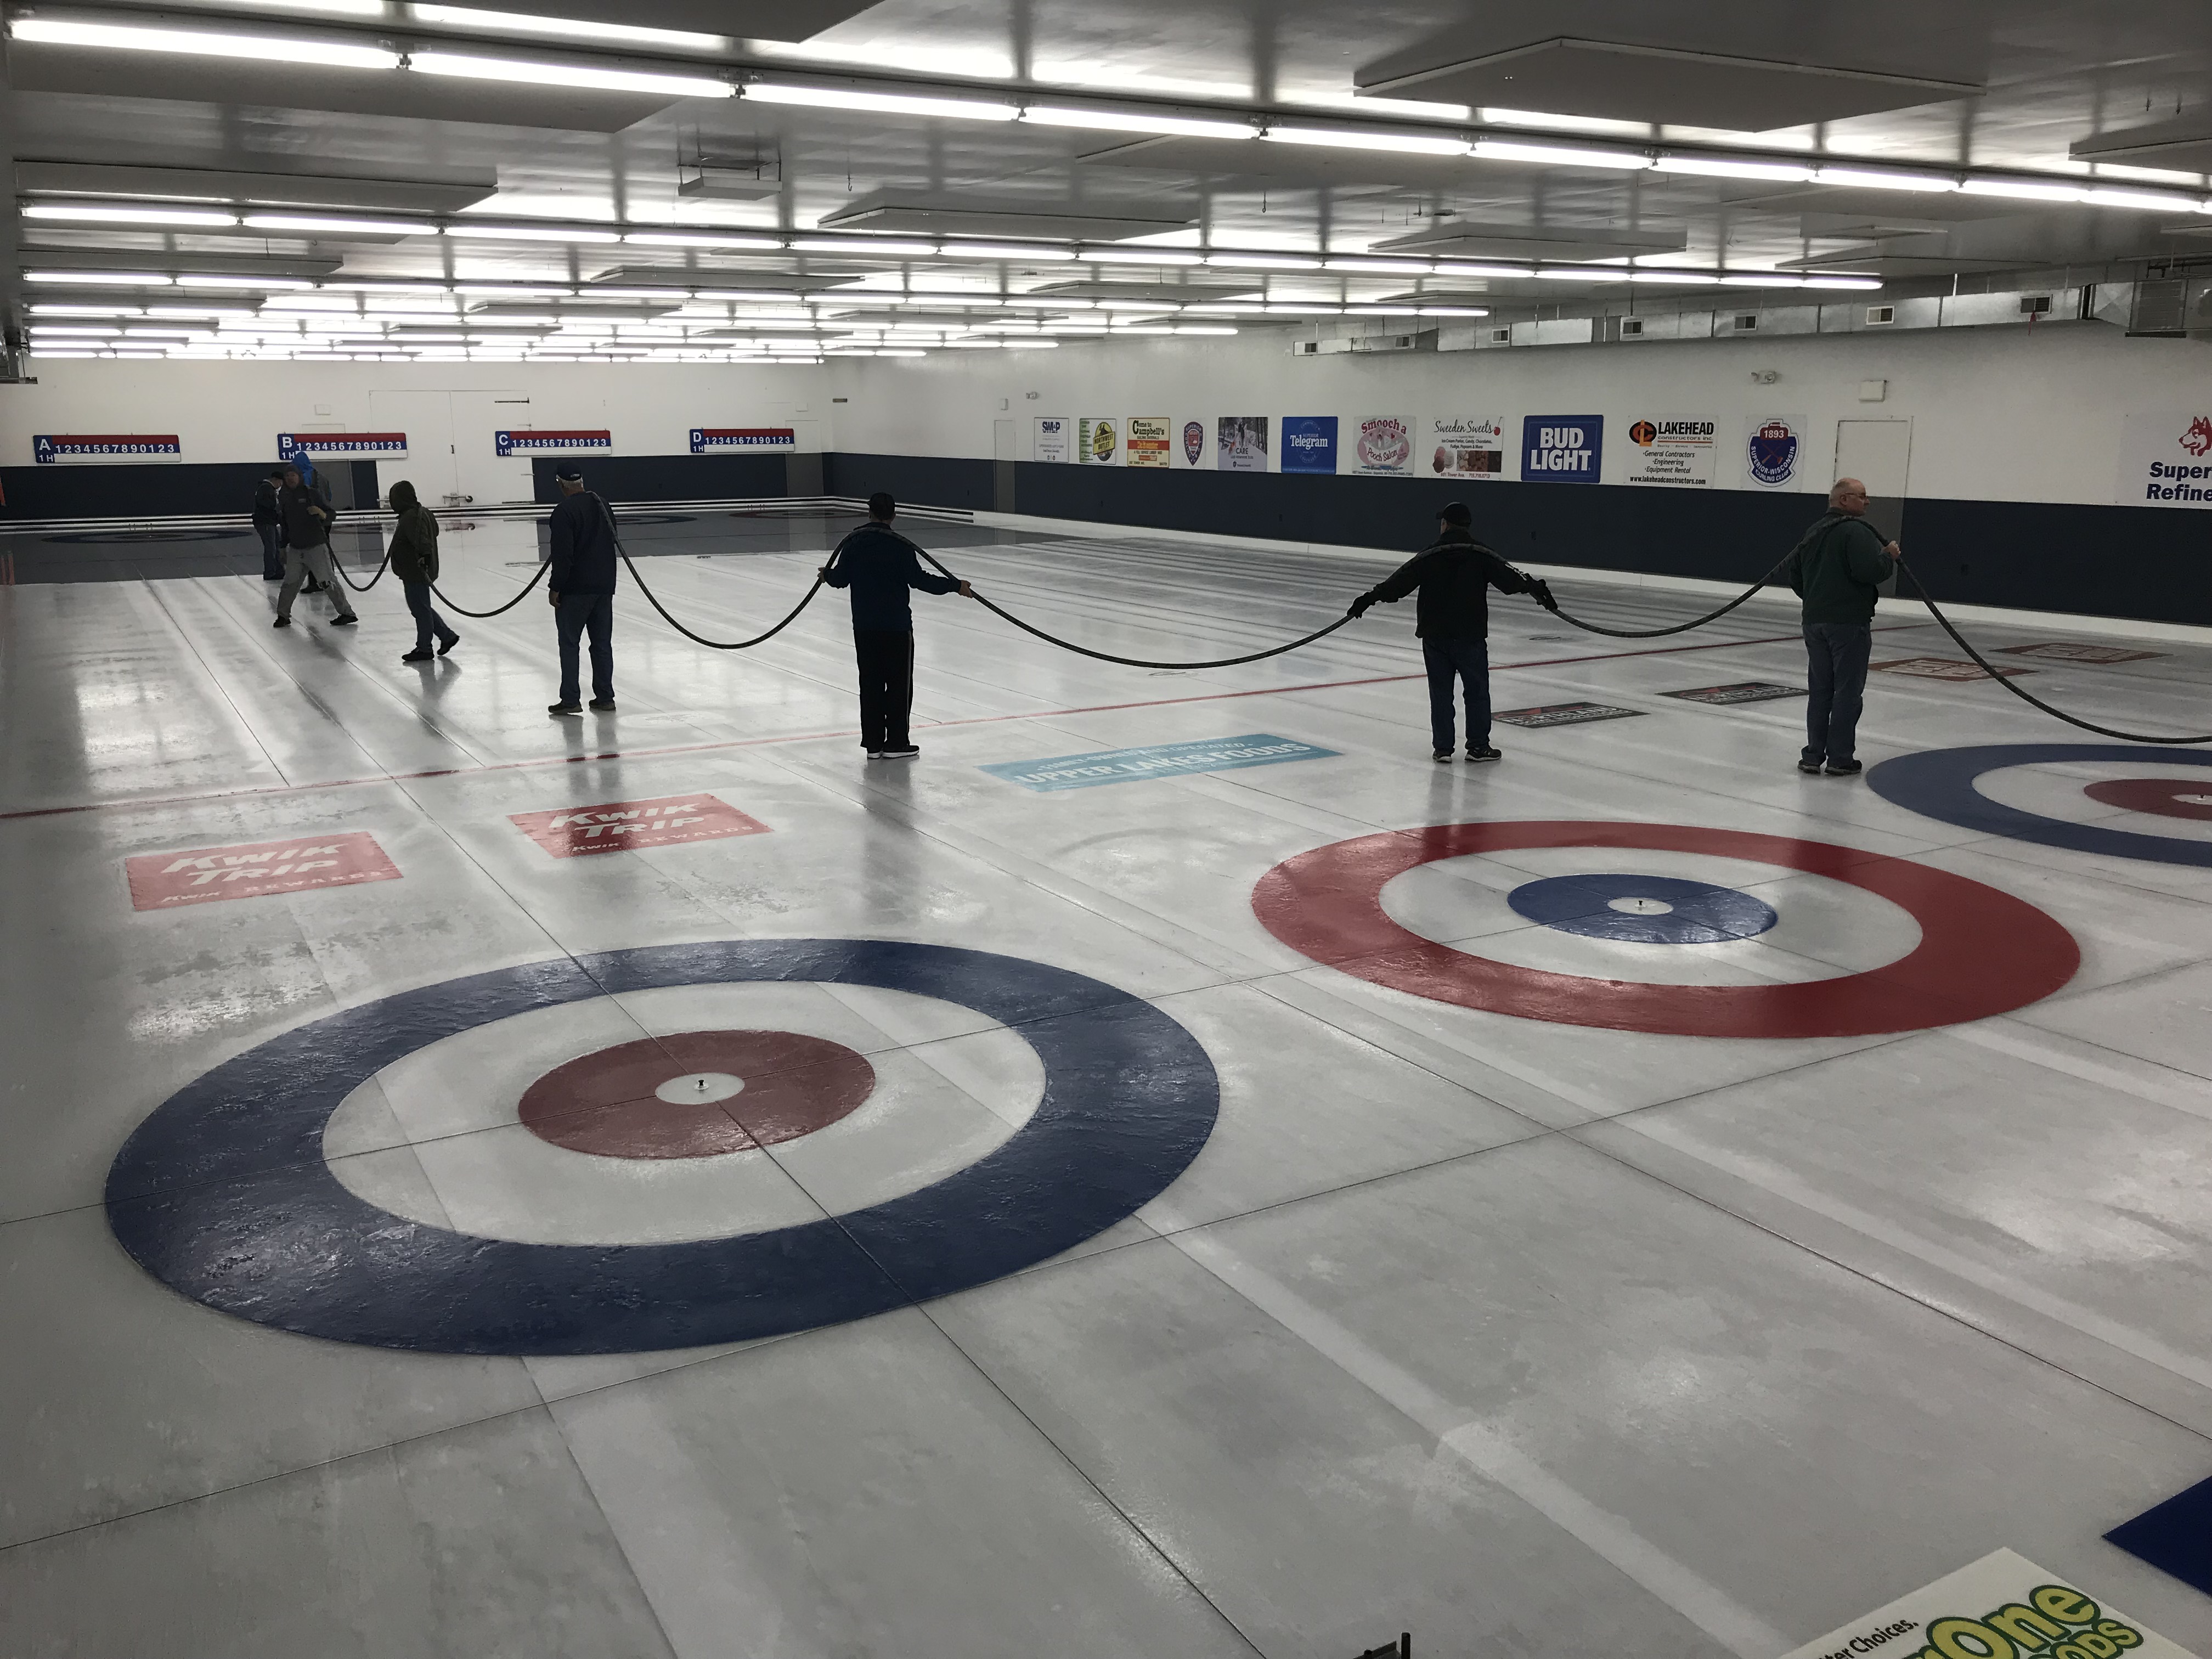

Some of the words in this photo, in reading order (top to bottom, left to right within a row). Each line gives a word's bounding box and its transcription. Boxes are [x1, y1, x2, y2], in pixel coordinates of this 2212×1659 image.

[1361, 419, 1400, 434] Smooch
[1401, 425, 1407, 435] a
[1434, 419, 1466, 433] Sweeden
[1466, 420, 1493, 433] Sweets
[1658, 422, 1714, 435] LAKEHEAD
[499, 434, 508, 445] C
[693, 432, 702, 442] D
[1540, 427, 1584, 448] BUD
[1764, 430, 1784, 438] 1893
[39, 439, 51, 451] A
[282, 437, 292, 448] B
[1290, 435, 1328, 450] Telegram
[1367, 447, 1383, 461] Pooch
[1383, 450, 1398, 461] Salon
[1531, 449, 1592, 471] LIGHT
[1630, 476, 1706, 484] www.lakeheadconstructors.com
[1755, 469, 1775, 482] CURLING
[1776, 469, 1789, 481] CLUB
[1014, 766, 1124, 783] UPPER
[1116, 754, 1217, 771] LAKES
[1207, 743, 1311, 760] FOODS
